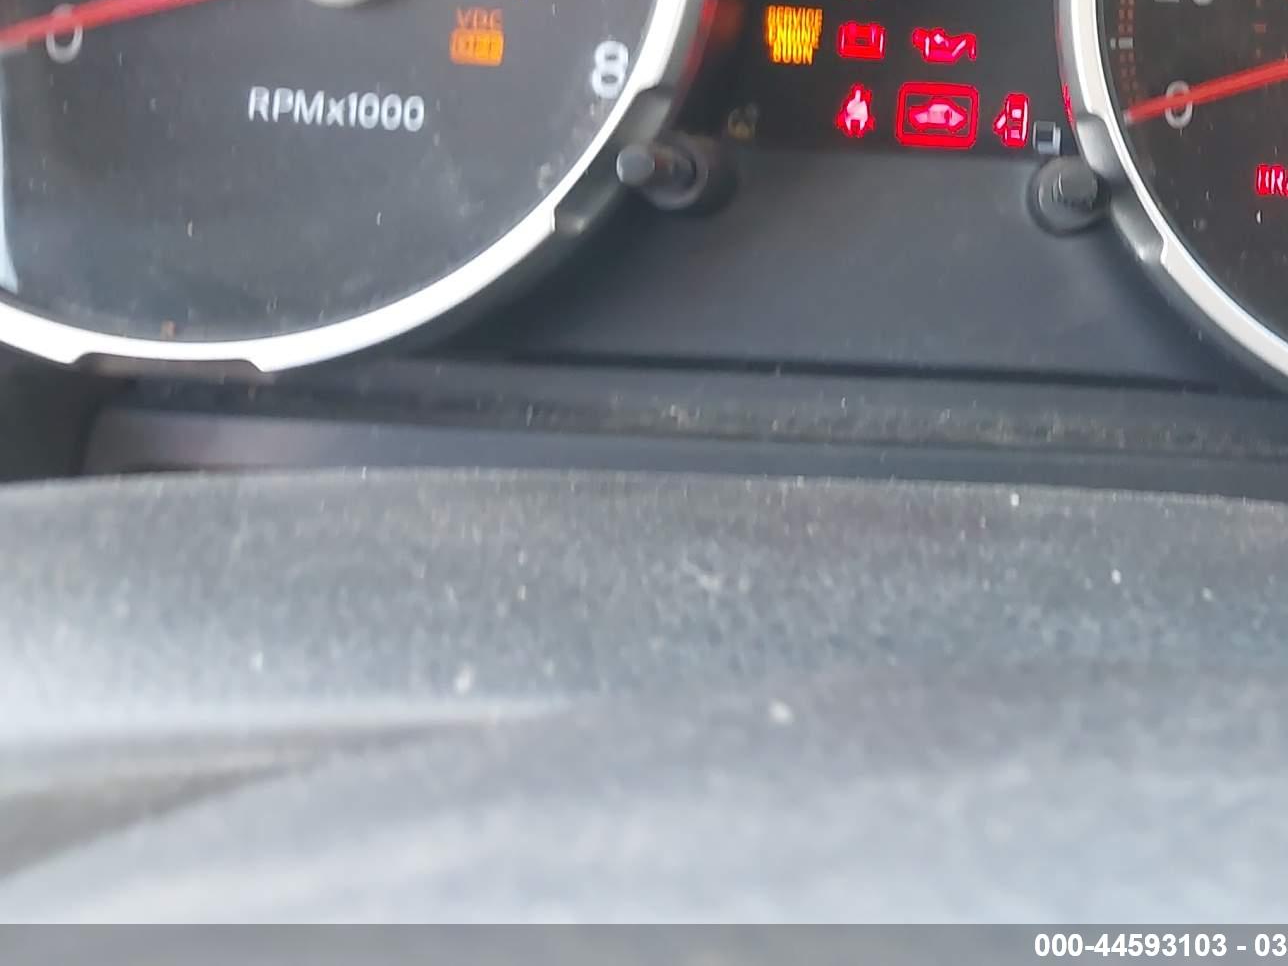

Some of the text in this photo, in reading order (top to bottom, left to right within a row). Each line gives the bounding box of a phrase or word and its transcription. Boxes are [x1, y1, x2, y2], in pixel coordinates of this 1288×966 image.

[45, 2, 84, 64] 0
[591, 40, 630, 99] 8
[248, 86, 426, 133] RPMx1000
[1162, 80, 1193, 128] 0
